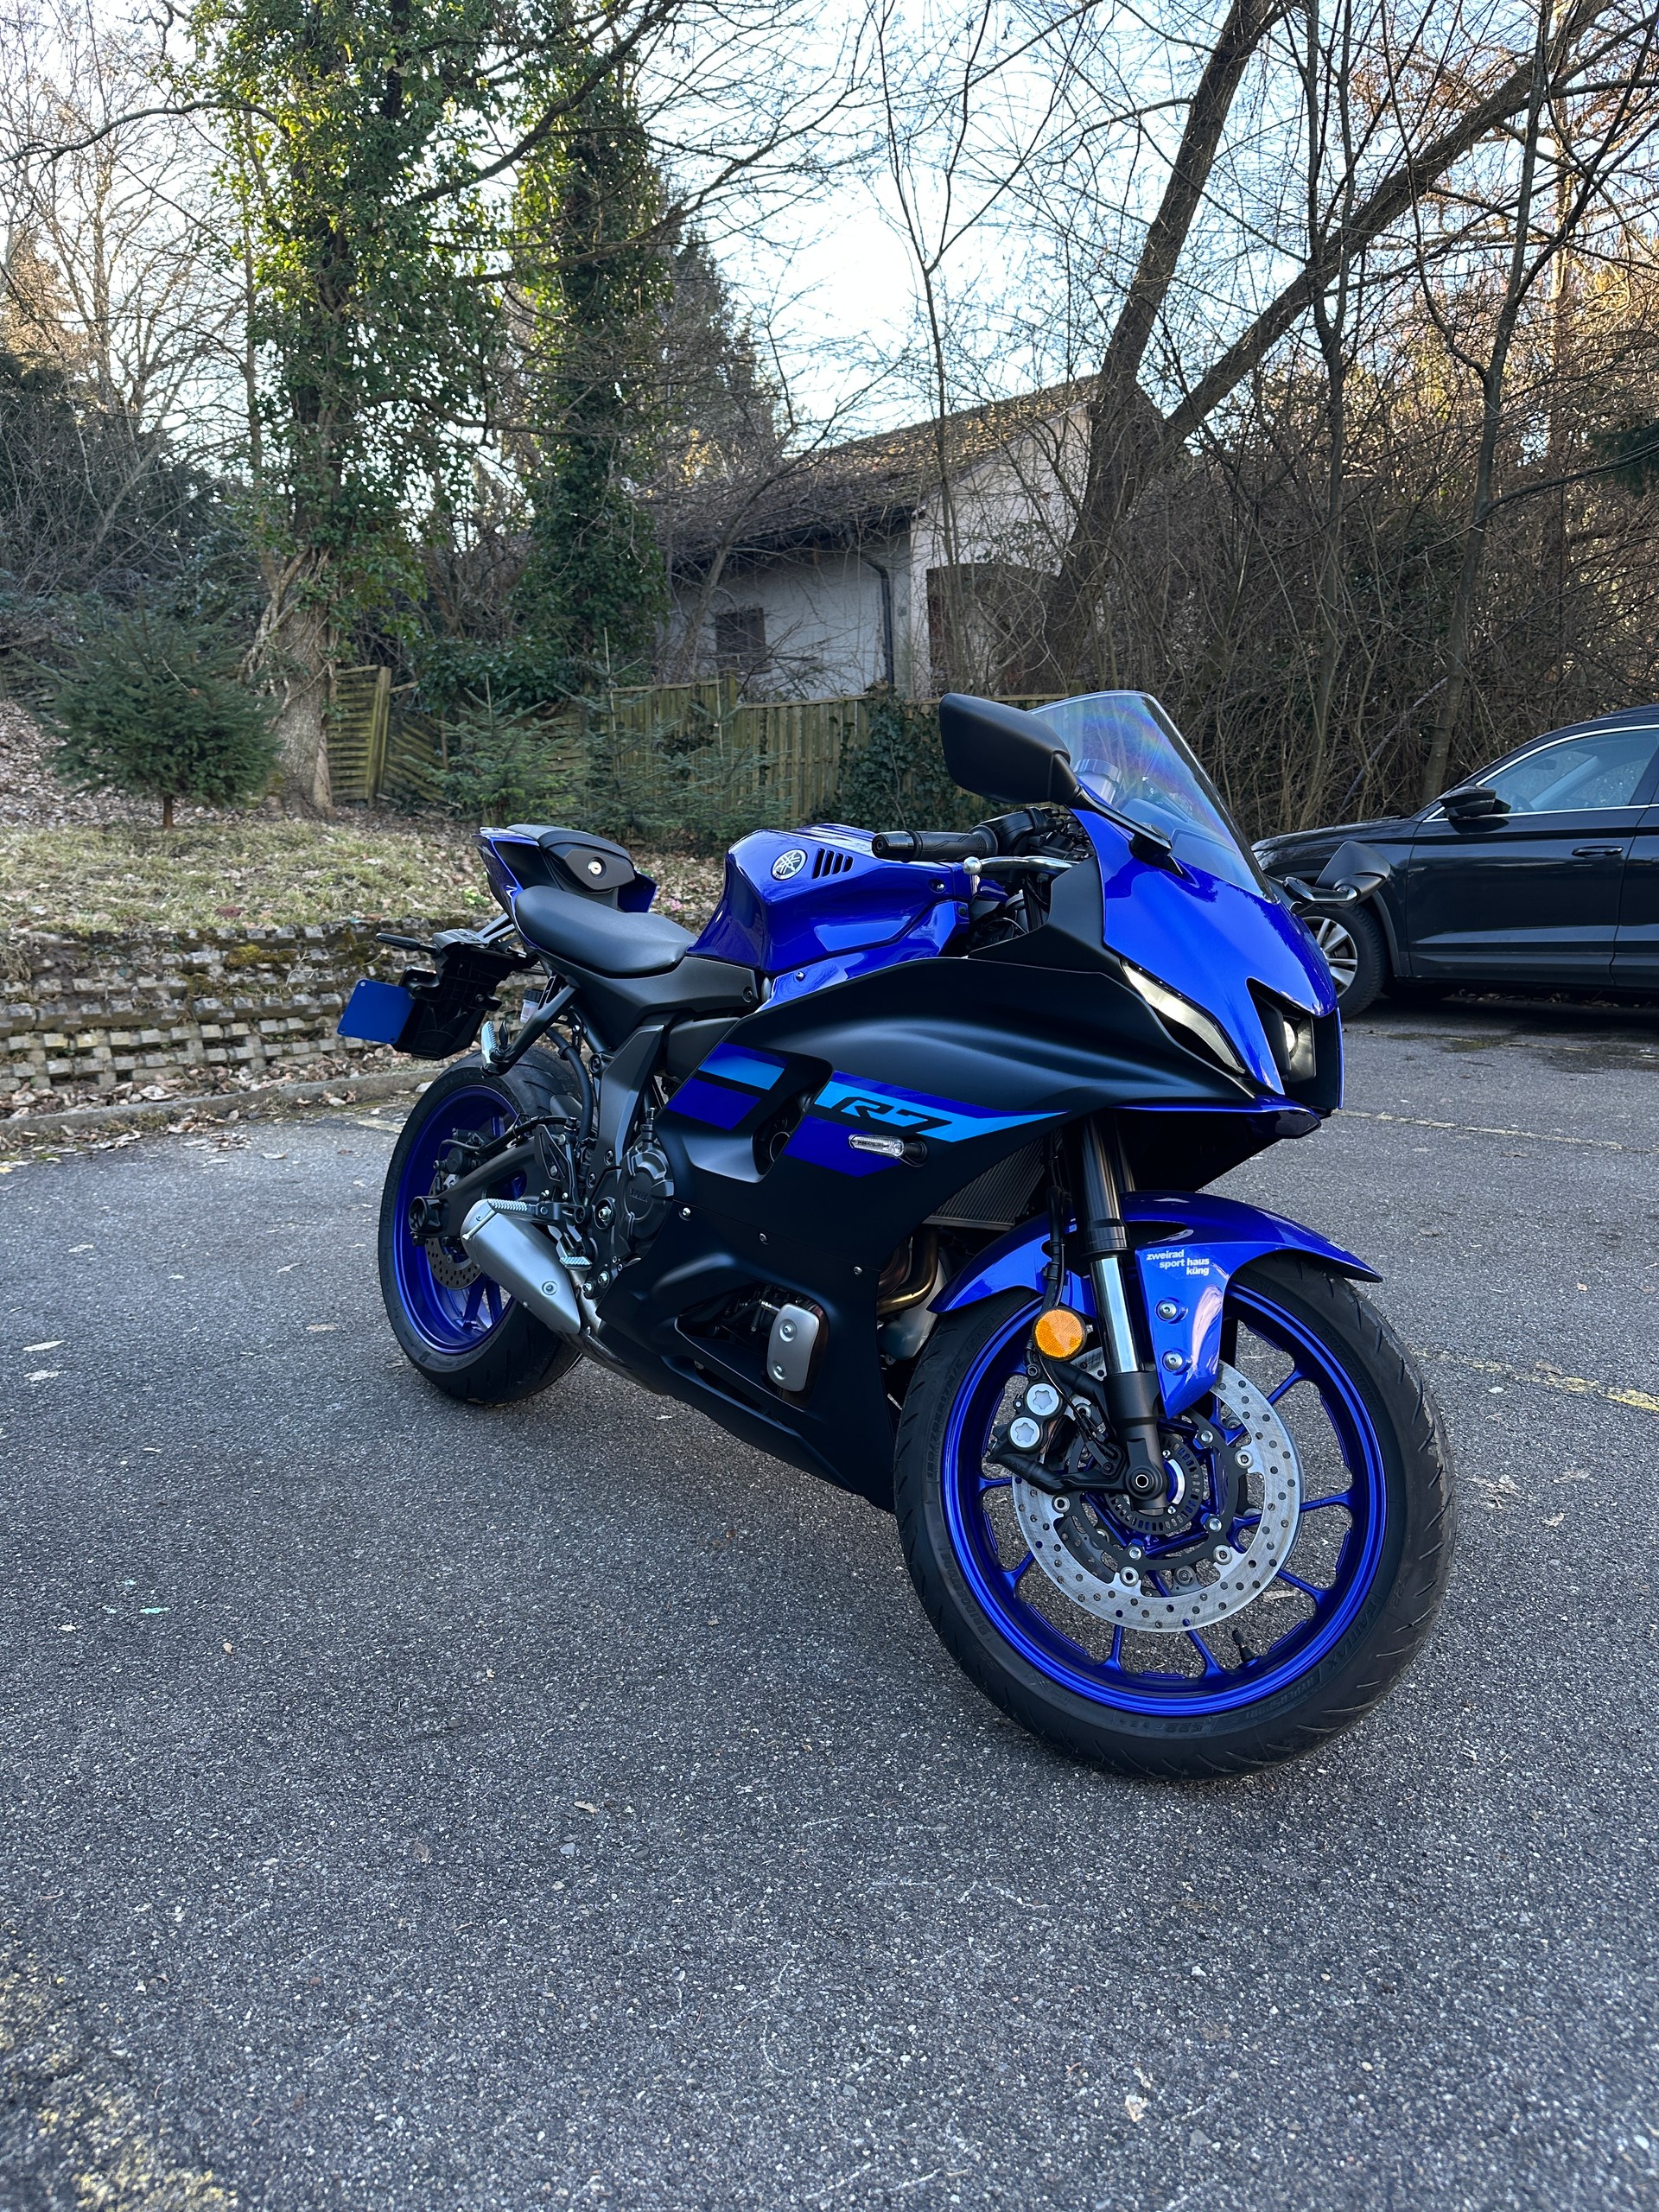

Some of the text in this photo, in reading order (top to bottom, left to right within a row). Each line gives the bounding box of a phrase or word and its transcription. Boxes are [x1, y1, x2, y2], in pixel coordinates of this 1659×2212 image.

[830, 1096, 953, 1133] R7
[1146, 1249, 1185, 1262] zweirad
[1159, 1257, 1210, 1270] sport haus
[1185, 1266, 1210, 1276] küng
[940, 1553, 993, 1635] BRIDGESTONE
[1326, 1600, 1379, 1669] BATTLAX
[1245, 1676, 1315, 1719] HYPERSPORT
